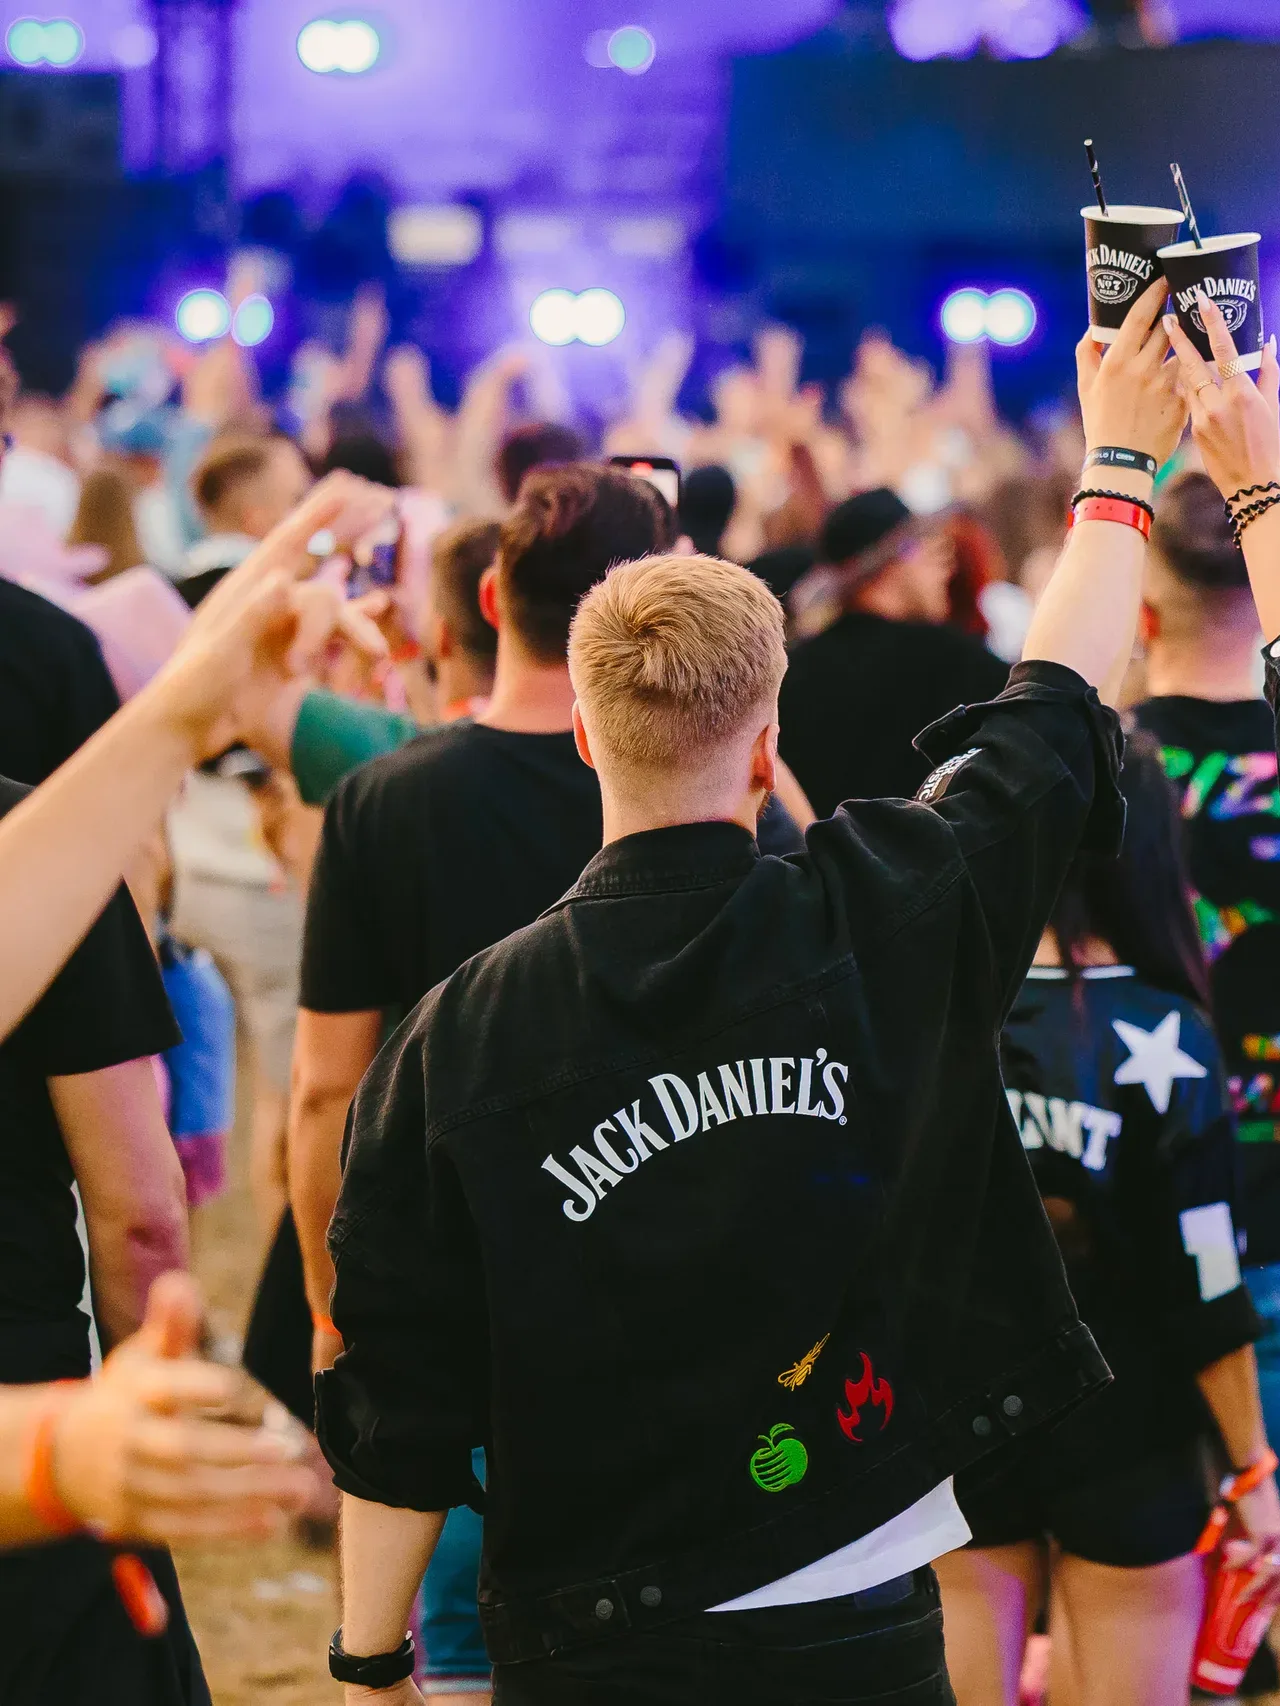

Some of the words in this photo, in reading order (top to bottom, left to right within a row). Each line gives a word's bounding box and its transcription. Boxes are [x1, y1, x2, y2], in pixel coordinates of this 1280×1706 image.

[1099, 244, 1154, 279] DANIEL'S
[1204, 277, 1256, 302] DANIEL'S
[541, 1098, 670, 1222] JACK
[648, 1047, 849, 1143] DANIEL'S
